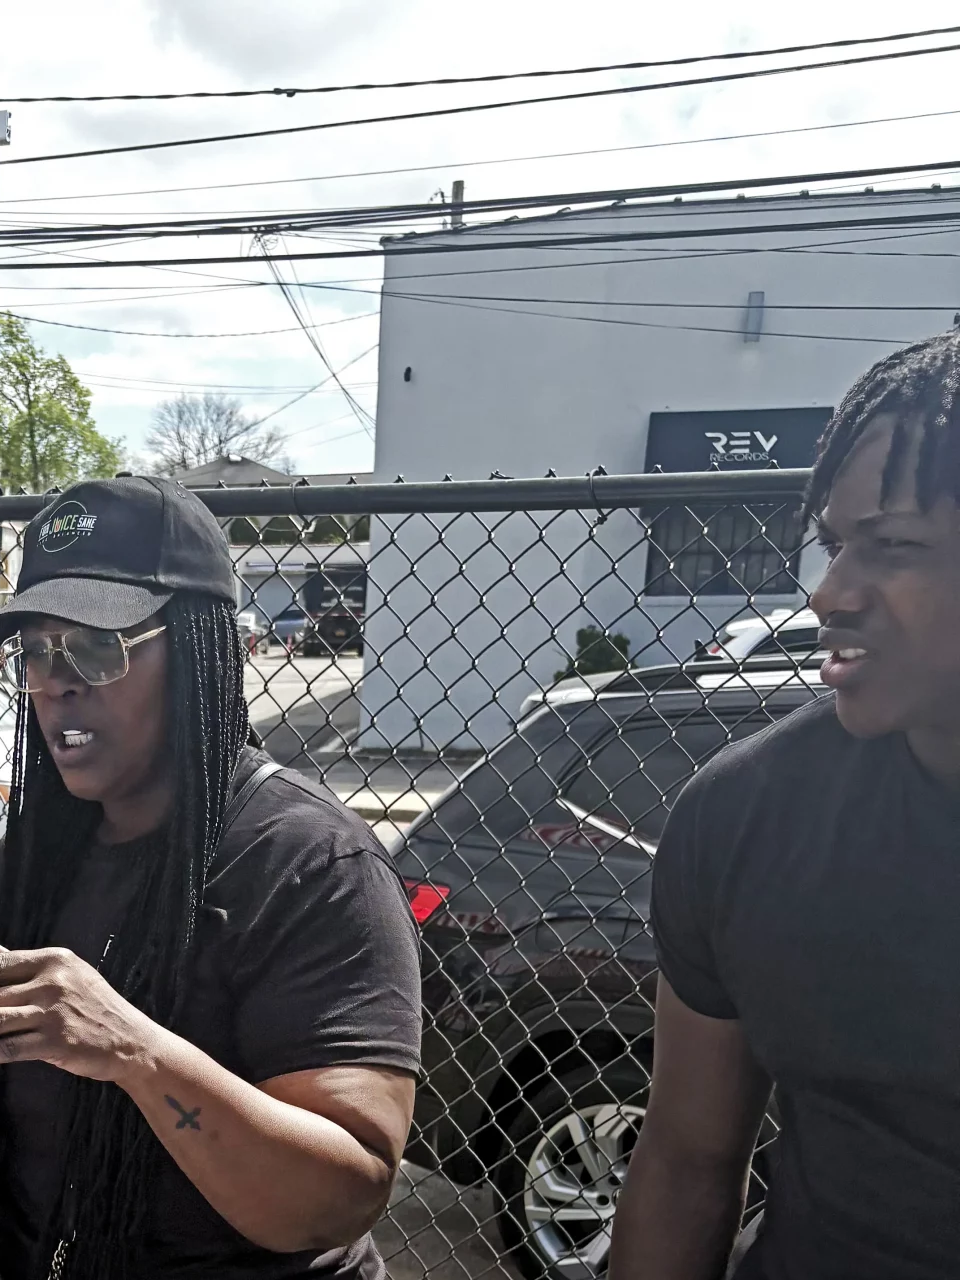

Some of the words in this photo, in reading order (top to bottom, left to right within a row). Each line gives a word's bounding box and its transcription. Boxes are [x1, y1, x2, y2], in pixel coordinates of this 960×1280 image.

[704, 431, 778, 453] REV
[709, 452, 769, 462] RECORDS
[49, 514, 79, 535] JUICE
